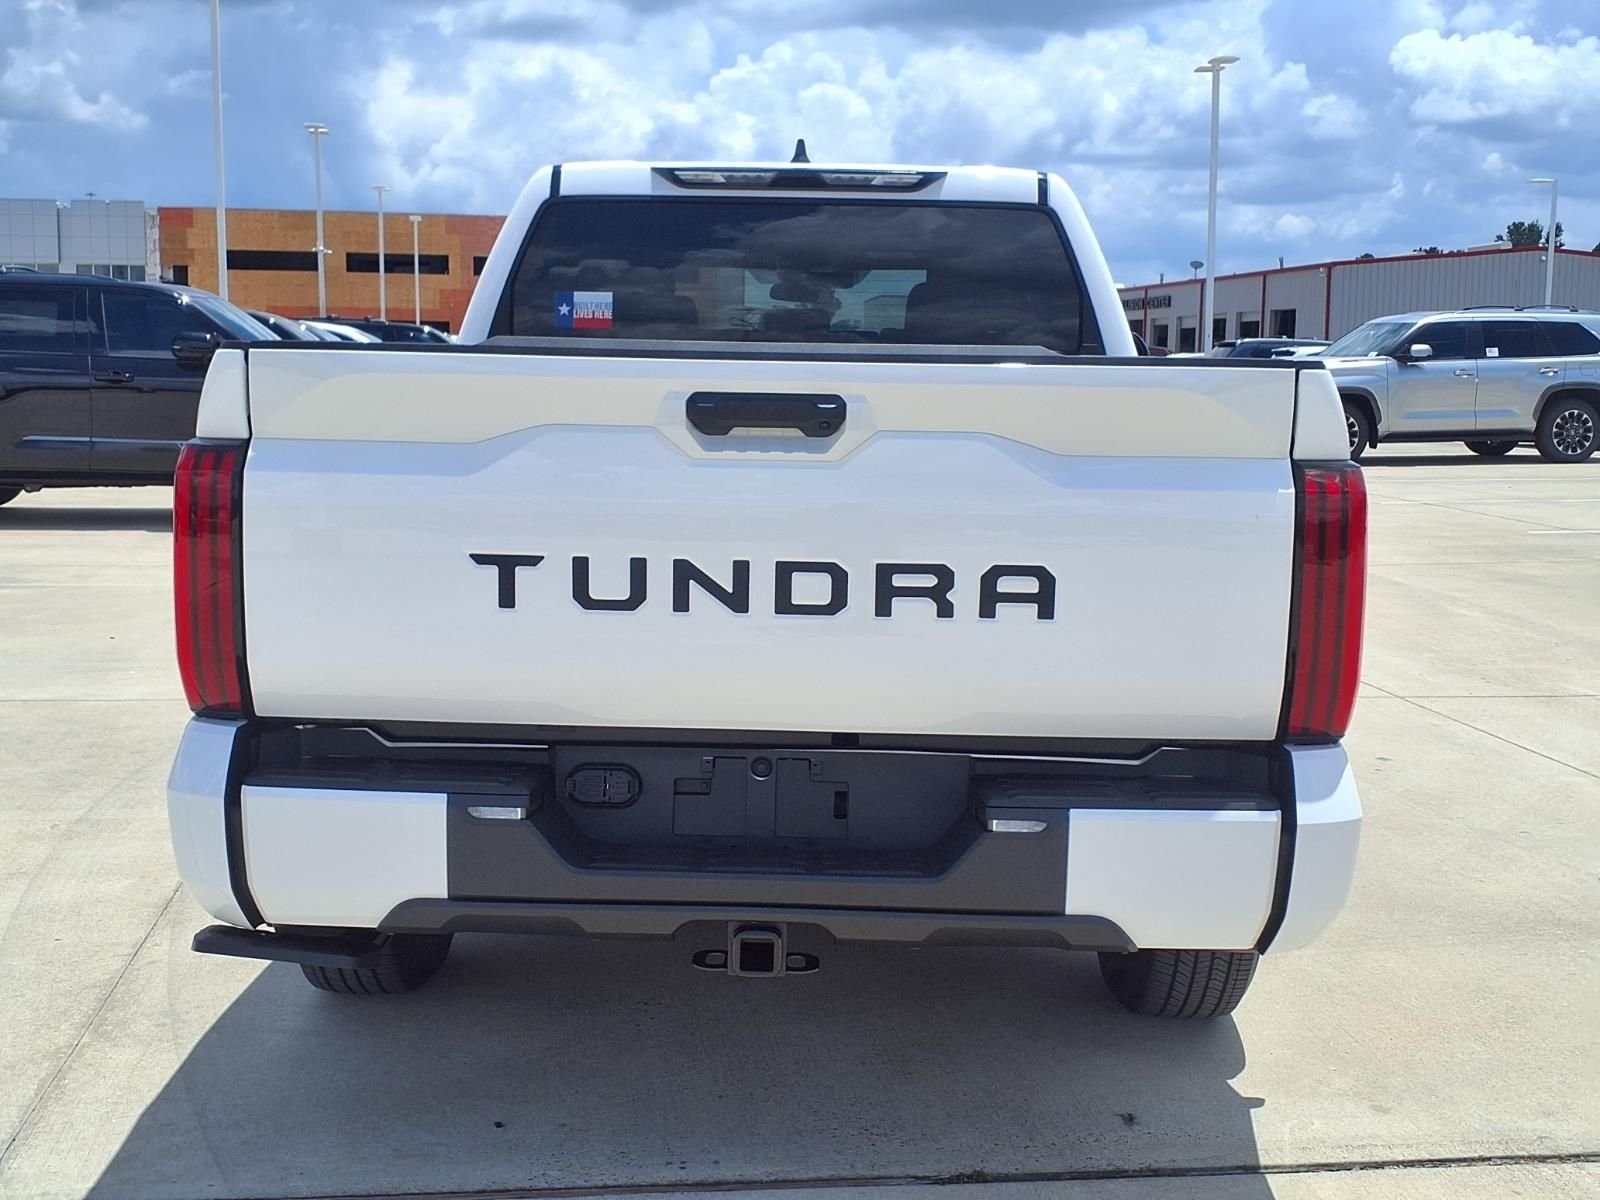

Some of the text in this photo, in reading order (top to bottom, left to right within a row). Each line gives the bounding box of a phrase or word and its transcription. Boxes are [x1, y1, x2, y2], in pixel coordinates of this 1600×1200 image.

[573, 309, 613, 320] LIVES HERE
[468, 553, 1056, 620] TUNDRA
